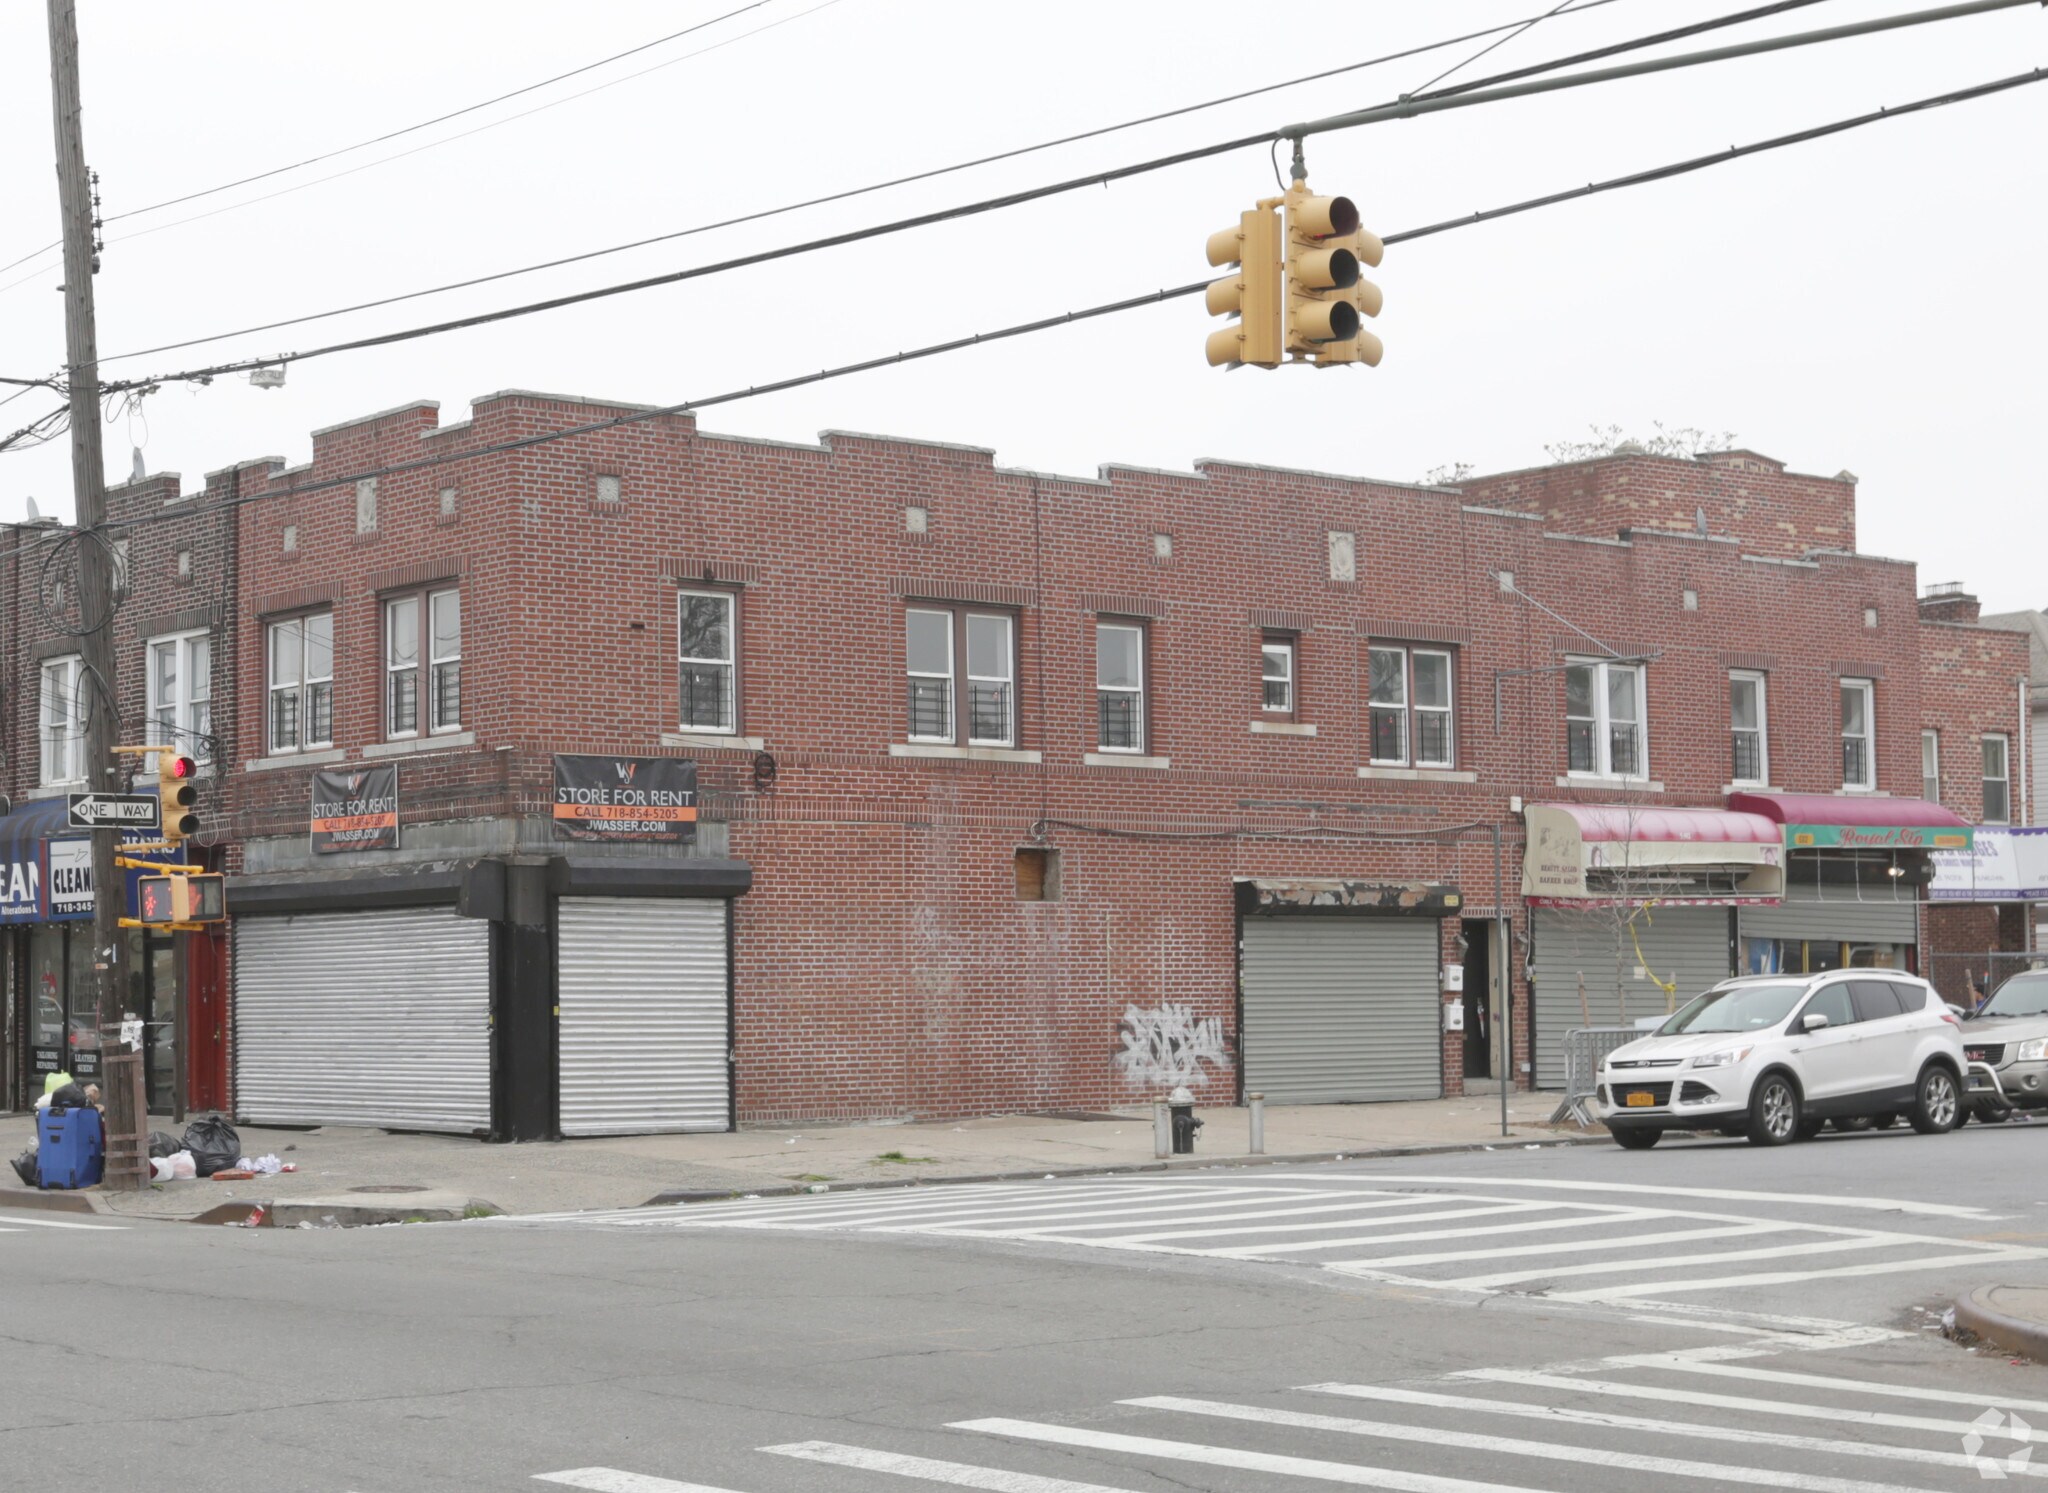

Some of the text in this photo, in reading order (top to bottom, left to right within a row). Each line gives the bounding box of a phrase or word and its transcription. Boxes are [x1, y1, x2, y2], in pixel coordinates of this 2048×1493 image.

[558, 787, 693, 806] STORE FOR RENT
[79, 803, 150, 817] ONE WAY
[314, 797, 394, 818] STORE FOR RENT
[575, 807, 678, 819] CALL 718-854-5205
[323, 815, 385, 830] CALL 718-854-5205
[586, 819, 667, 832] JWASSER.COM
[332, 828, 380, 842] JWASSER.COM
[1838, 828, 1890, 847] Royal
[54, 866, 93, 894] CLEAN
[1964, 1050, 1985, 1060] MC
